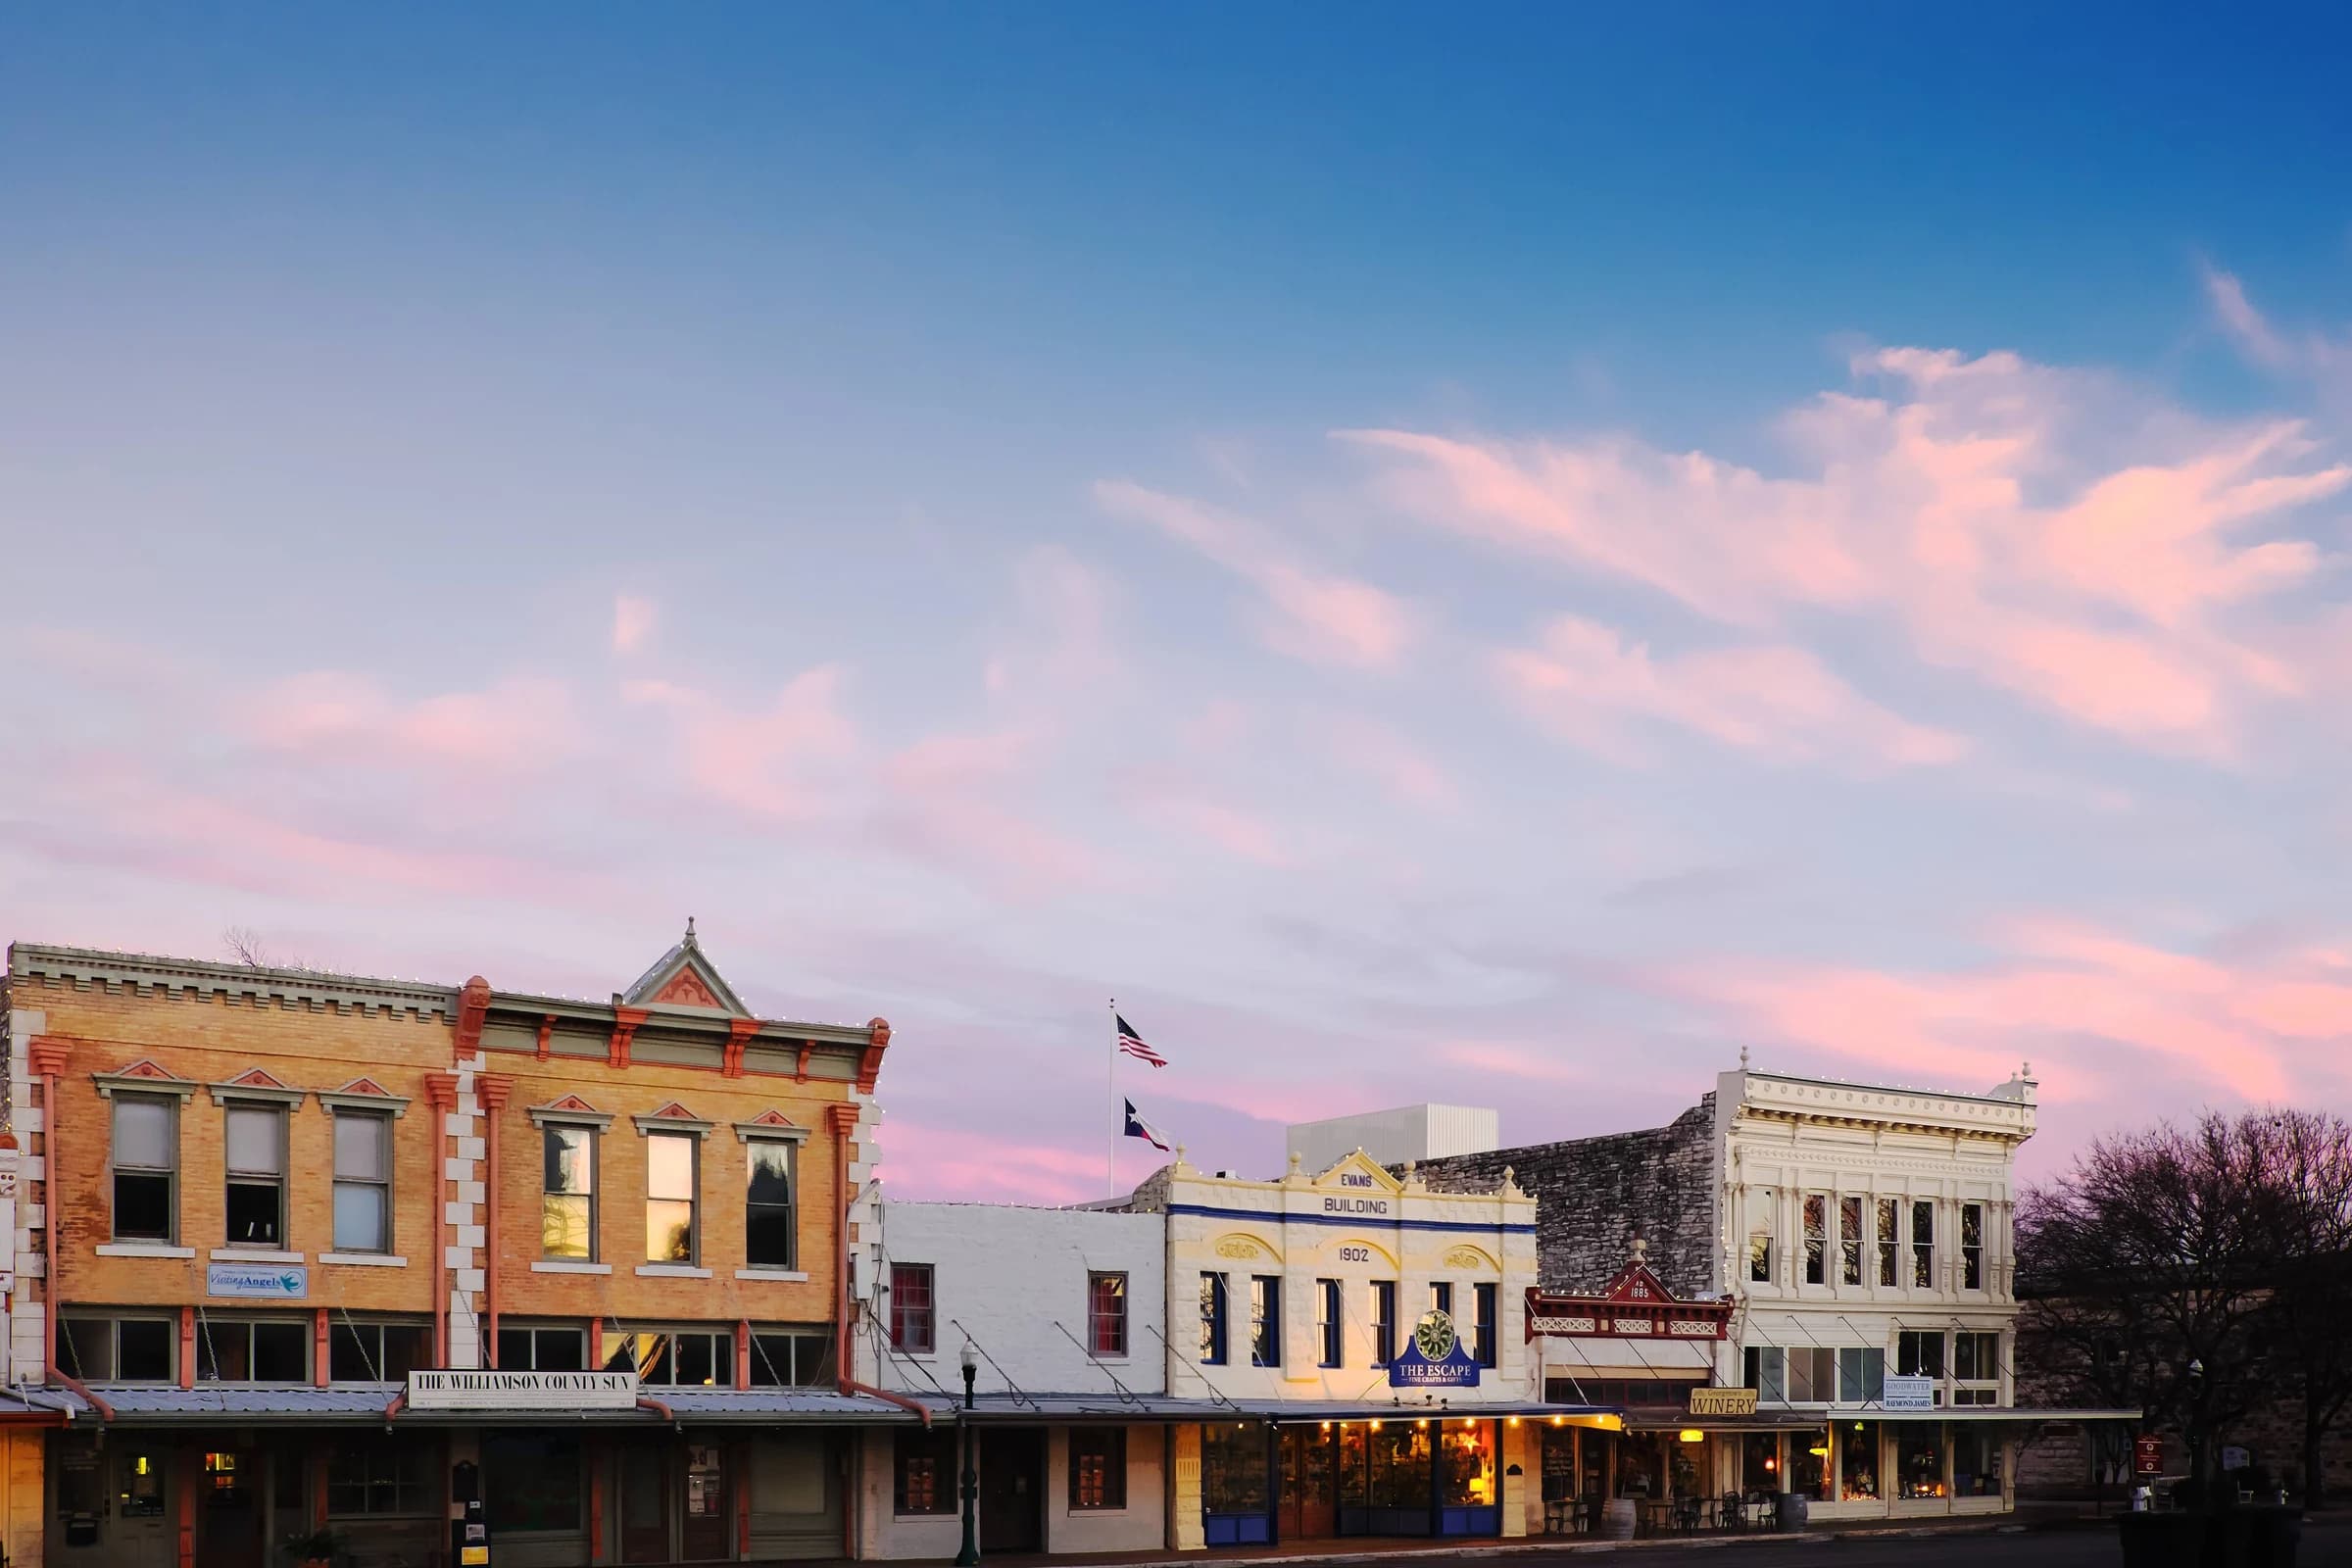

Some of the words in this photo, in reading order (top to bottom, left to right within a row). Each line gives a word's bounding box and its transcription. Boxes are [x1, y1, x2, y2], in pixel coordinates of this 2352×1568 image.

[1341, 1174, 1372, 1187] EVANS
[1325, 1198, 1387, 1214] BUILDING
[1340, 1248, 1369, 1262] 1902
[242, 1276, 281, 1287] Angels
[1631, 1287, 1649, 1298] 1885
[1399, 1364, 1424, 1377] THE
[1427, 1364, 1472, 1377] ESCAPE
[416, 1374, 445, 1390] THE
[450, 1374, 540, 1390] WILLIAMSON
[545, 1375, 599, 1390] COUNTY
[603, 1375, 629, 1390] SUN
[1692, 1397, 1755, 1414] WINERY
